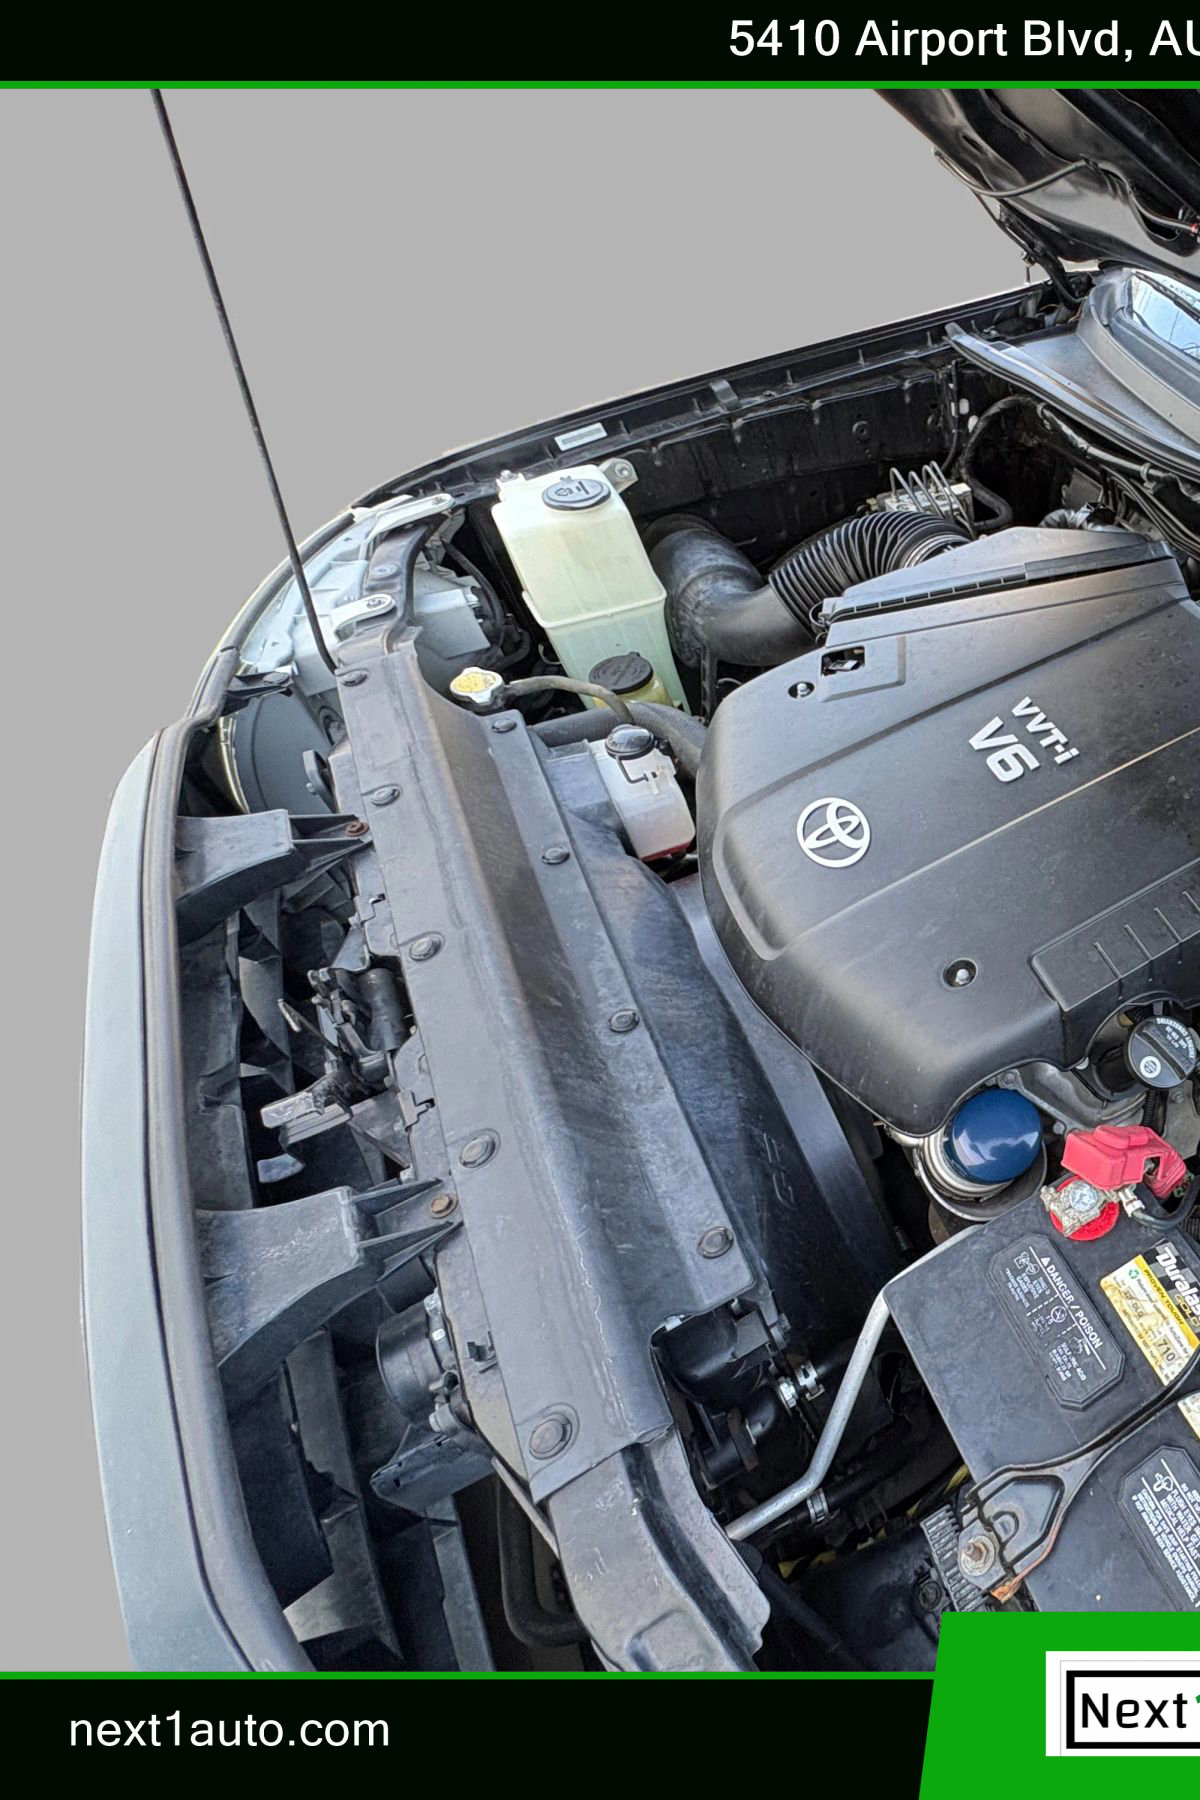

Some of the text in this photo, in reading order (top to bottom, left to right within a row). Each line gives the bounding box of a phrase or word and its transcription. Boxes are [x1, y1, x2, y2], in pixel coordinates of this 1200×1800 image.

[968, 716, 1040, 782] V6
[1011, 697, 1079, 764] VVT-i
[1045, 1264, 1074, 1304] DANGER
[1074, 1310, 1102, 1348] POISON
[1173, 1292, 1200, 1327] GOLD
[1156, 1338, 1176, 1362] 710
[1158, 1498, 1200, 1560] MEDICAL HELP FAST
[1165, 1493, 1179, 1511] WITH
[1189, 1533, 1200, 1548] GET
[1170, 1488, 1187, 1510] FLUSH
[1182, 1508, 1197, 1526] EYES
